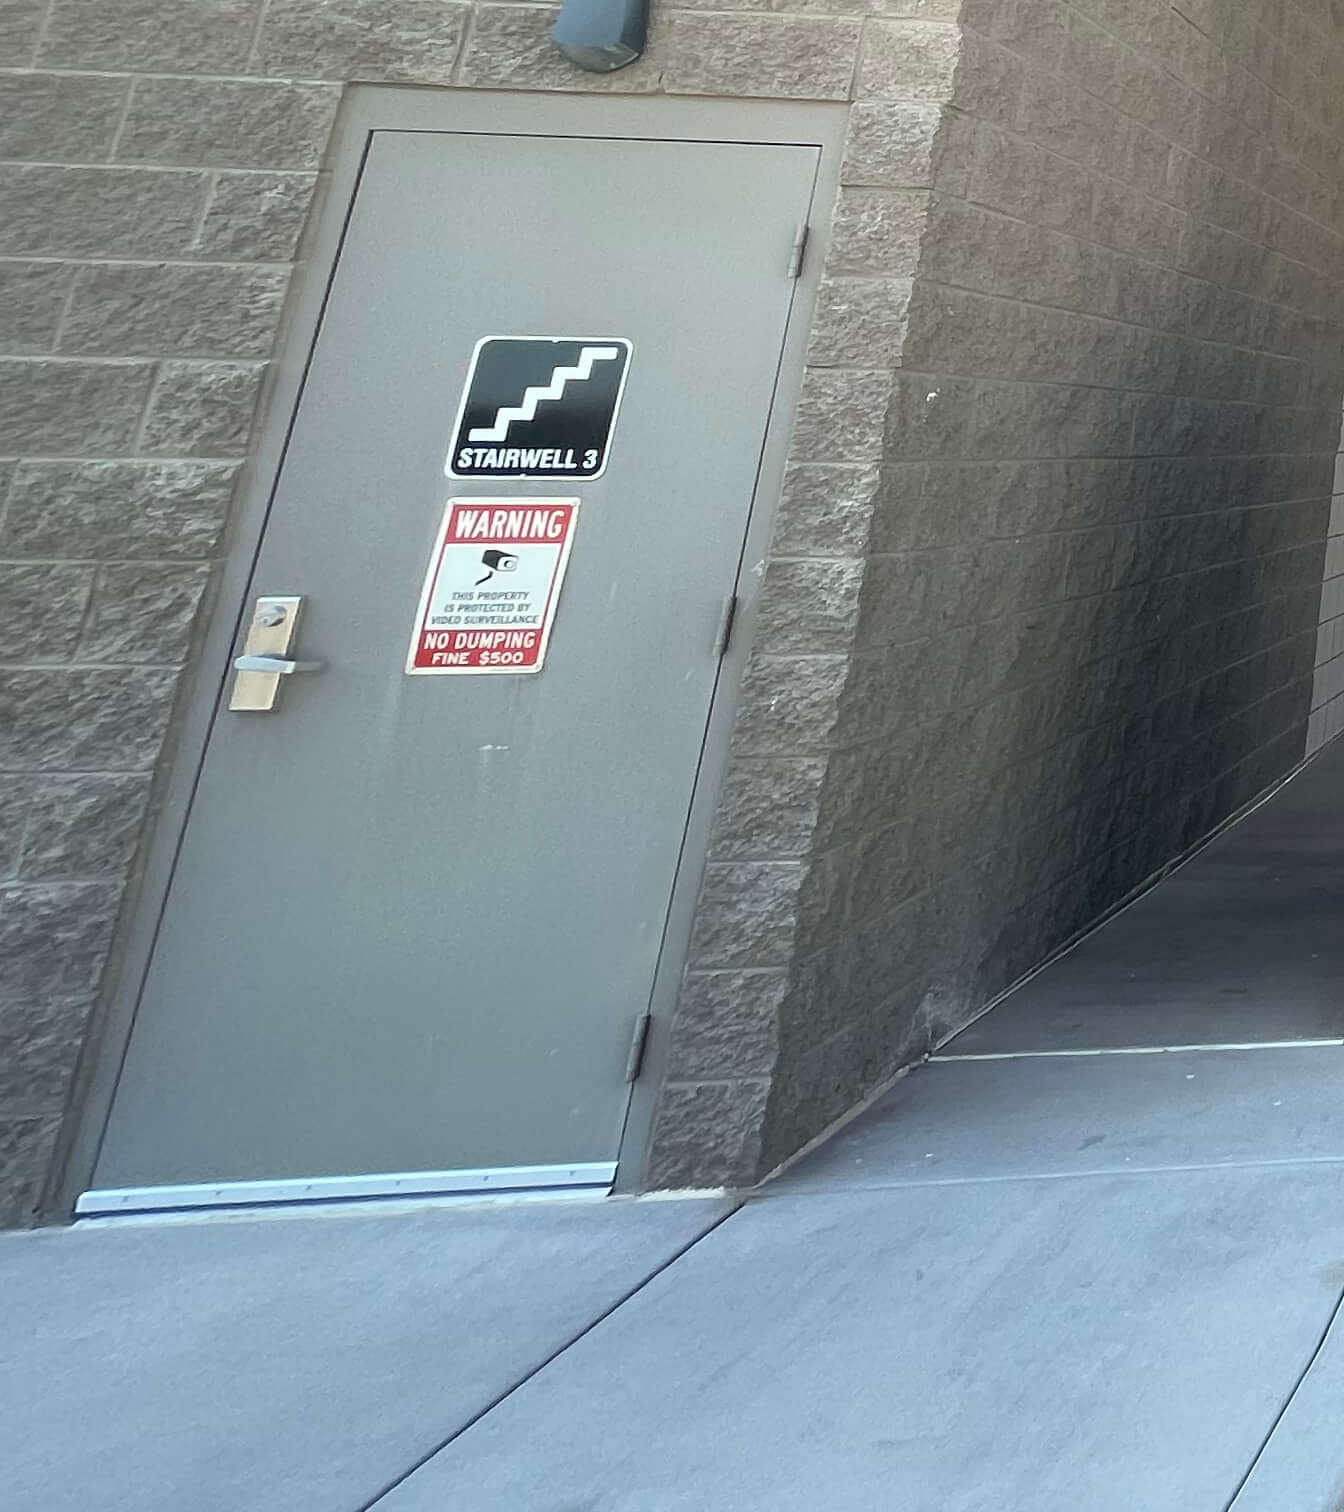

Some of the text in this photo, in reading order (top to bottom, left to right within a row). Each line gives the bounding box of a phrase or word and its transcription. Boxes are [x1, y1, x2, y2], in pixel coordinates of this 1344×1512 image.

[457, 448, 598, 468] STAIRWELL 3
[455, 510, 565, 539] WARNING
[451, 592, 530, 601] THIS PROPERTY
[444, 603, 531, 613] IS PROTECTED BY
[431, 615, 539, 625] VIDEO SURVEILLANCE
[424, 632, 536, 649] NO DUMPING
[431, 651, 524, 665] FINE $500
